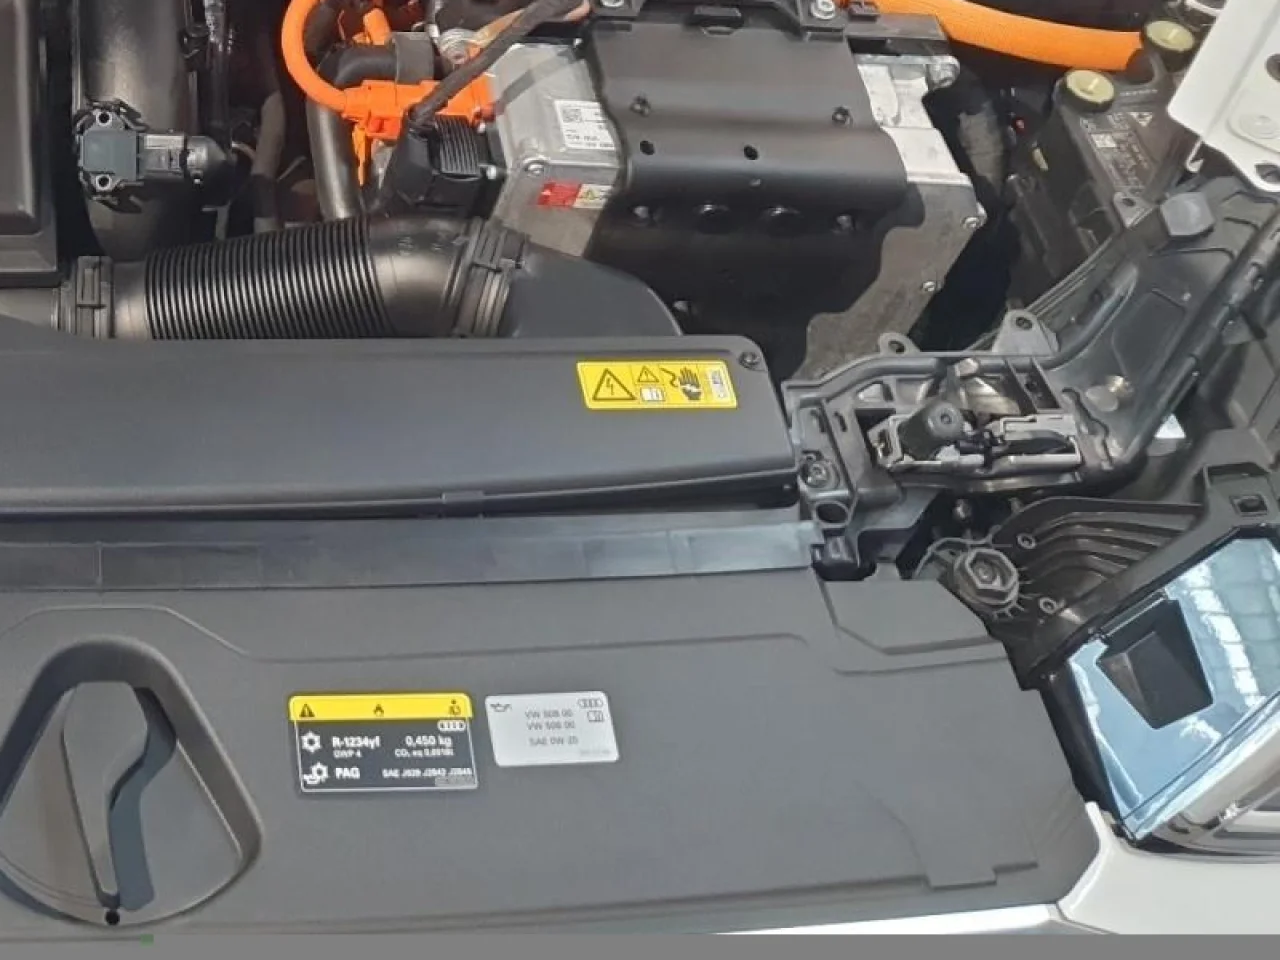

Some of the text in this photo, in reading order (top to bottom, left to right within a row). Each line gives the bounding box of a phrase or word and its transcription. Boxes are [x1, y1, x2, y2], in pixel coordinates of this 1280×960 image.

[332, 735, 380, 750] R-1234yf
[438, 734, 452, 748] kg
[335, 767, 360, 780] PAG
